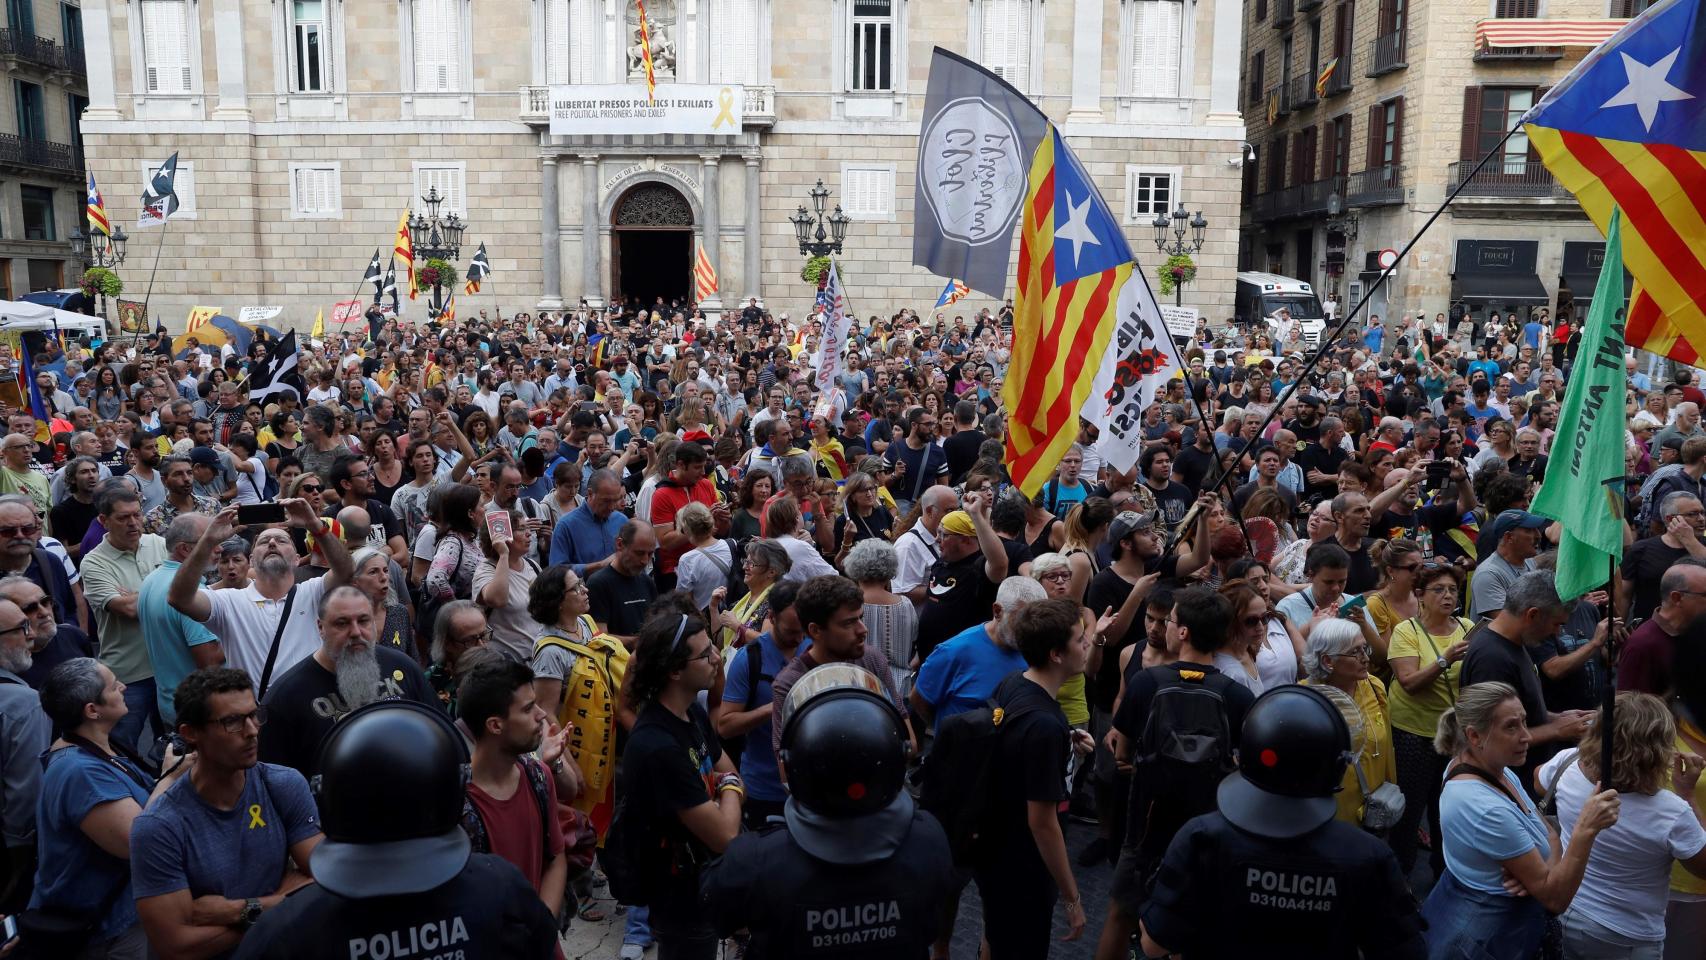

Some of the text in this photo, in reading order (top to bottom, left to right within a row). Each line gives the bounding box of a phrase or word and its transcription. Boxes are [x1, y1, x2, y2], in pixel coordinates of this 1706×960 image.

[555, 100, 596, 109] LLIBERTAT
[599, 100, 630, 109] PRESOS
[678, 99, 713, 108] EXILIATS
[555, 109, 666, 119] FREE POLITICAL PRISONERS AND EXILES
[605, 174, 622, 190] PALAU
[1483, 252, 1509, 260] TOUCH
[580, 679, 595, 700] LA
[577, 708, 588, 719] A
[571, 726, 583, 760] CAP
[1246, 867, 1337, 896] POLICIA
[1249, 892, 1332, 911] D310A4148
[806, 900, 901, 931] POLICIA
[349, 916, 470, 960] POLICIA
[812, 925, 897, 947] D310A7706
